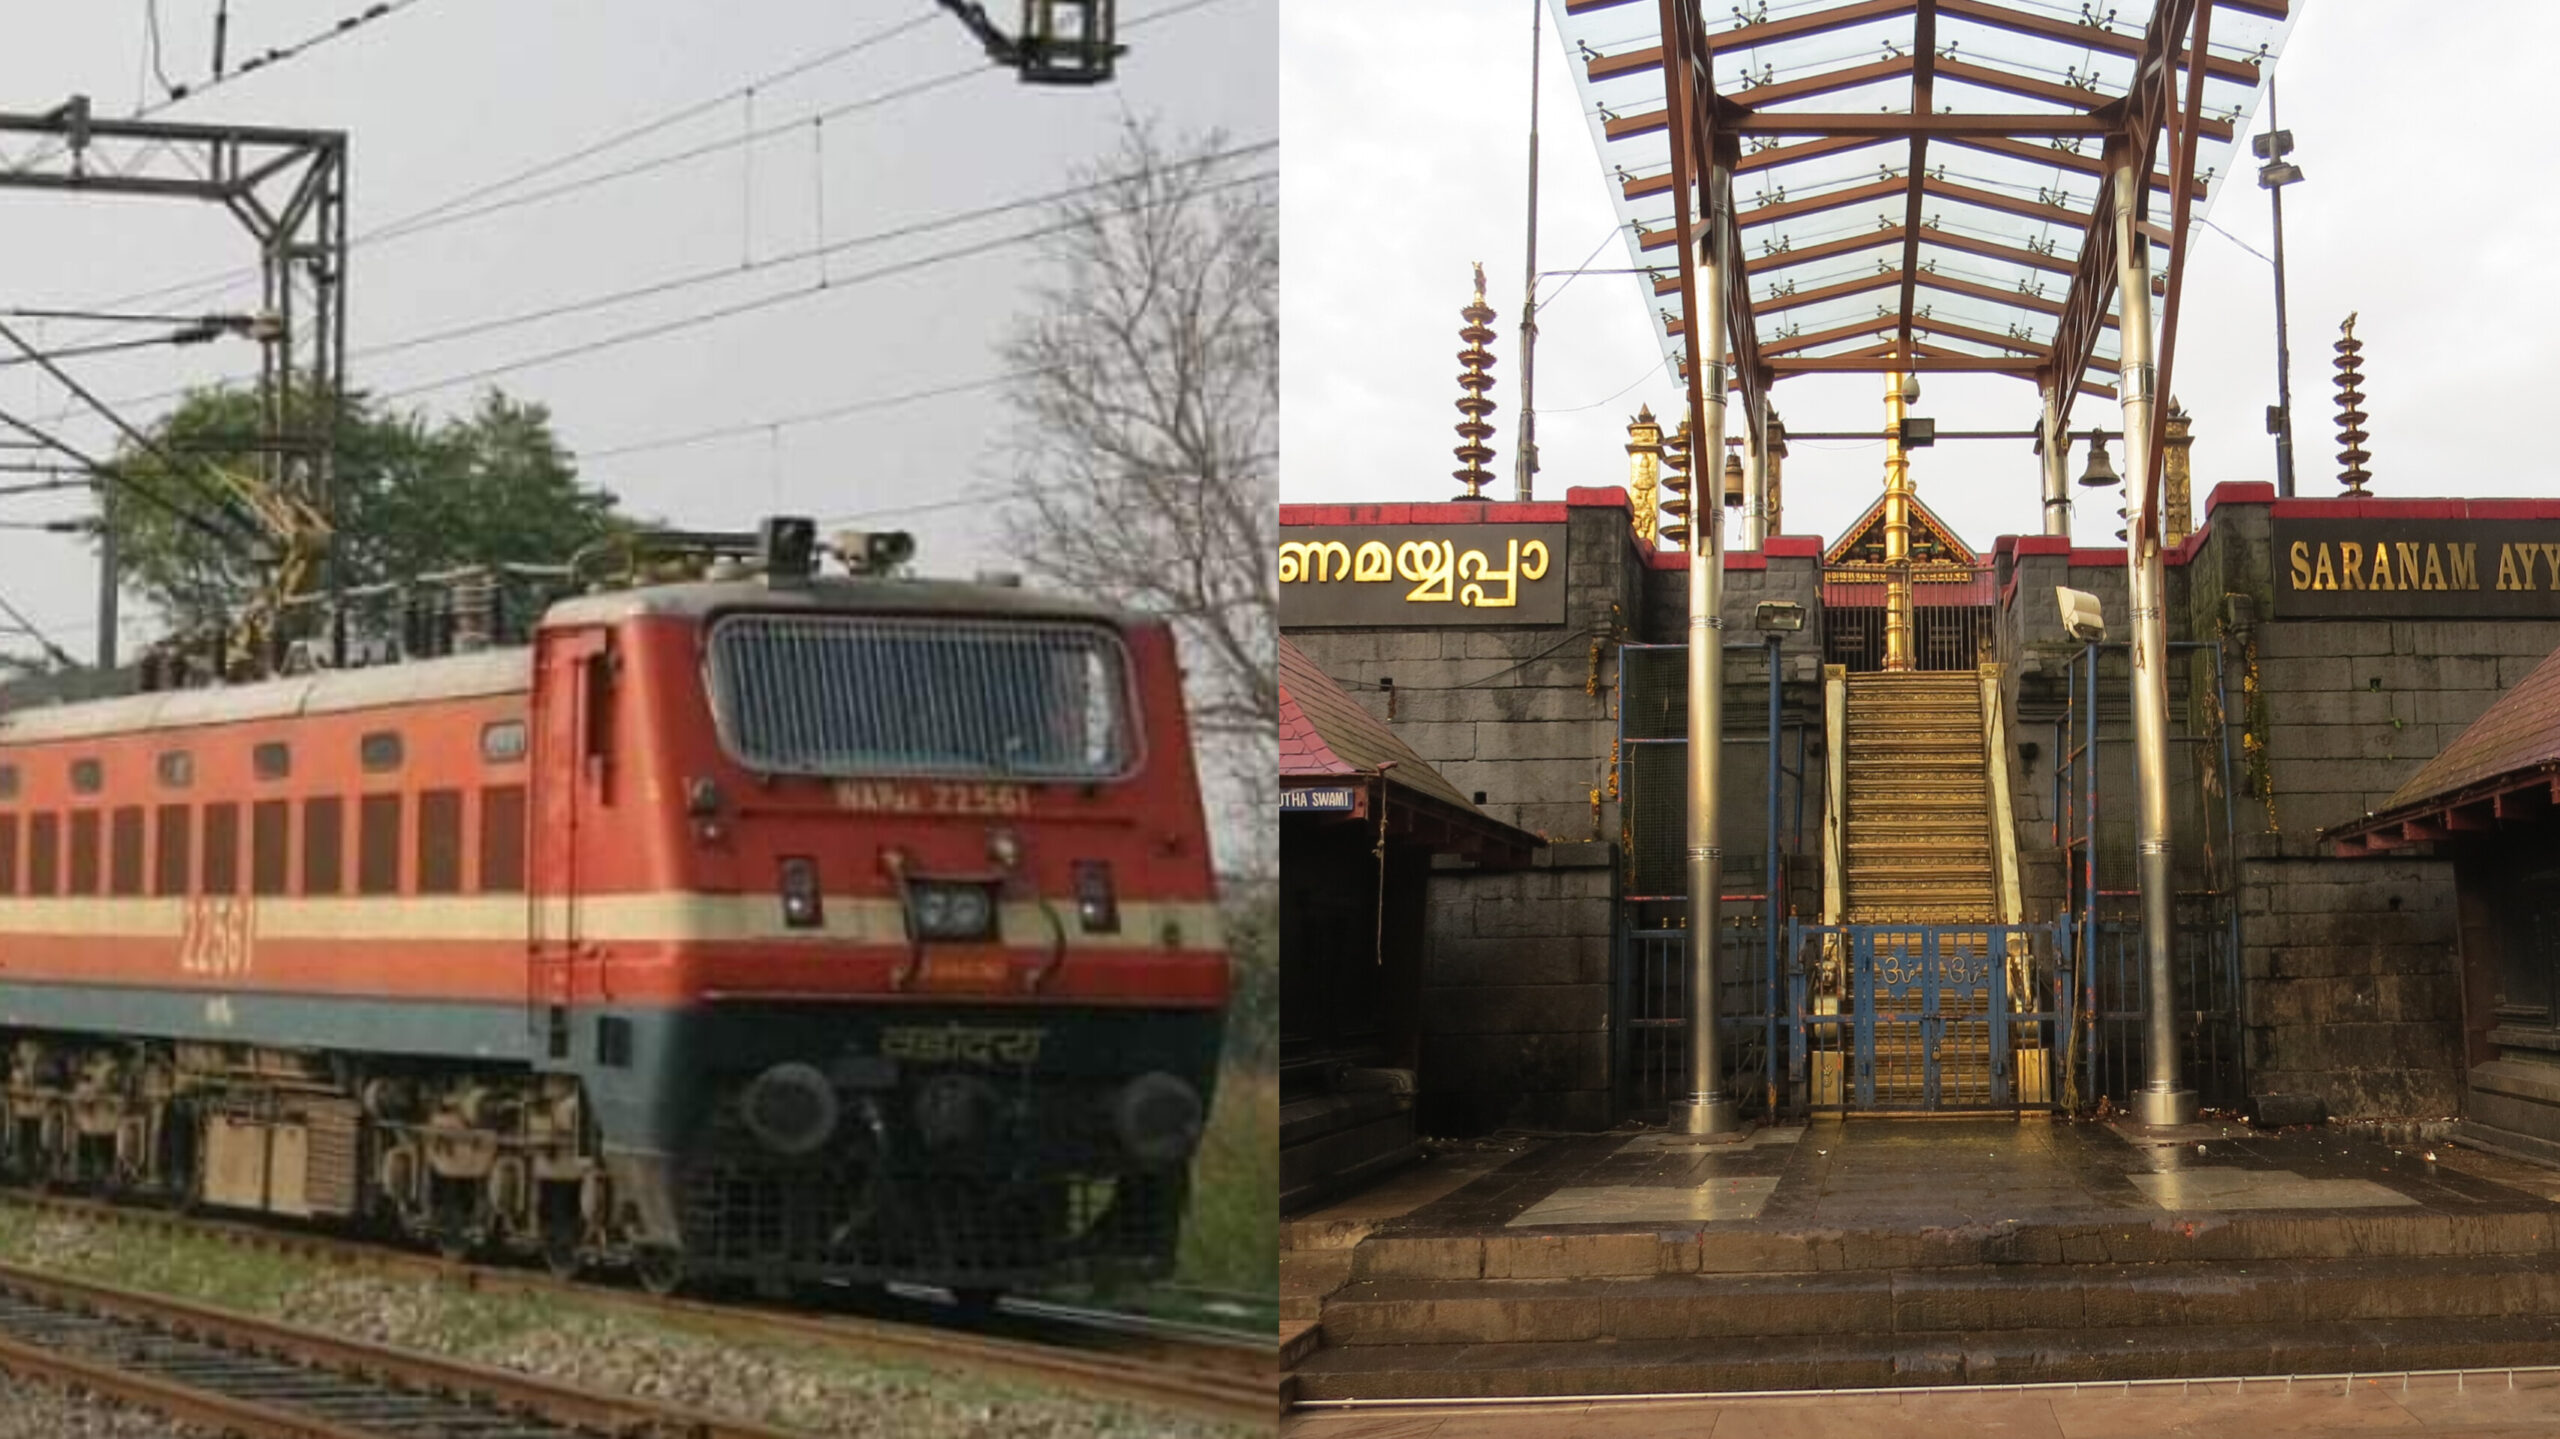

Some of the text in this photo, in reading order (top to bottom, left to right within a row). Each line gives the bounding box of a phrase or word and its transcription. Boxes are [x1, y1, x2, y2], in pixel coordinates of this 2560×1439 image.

[2290, 541, 2480, 590] SARANAM
[931, 784, 1031, 815] 22561
[1312, 791, 1349, 807] SWAMI
[181, 898, 254, 974] 22561
